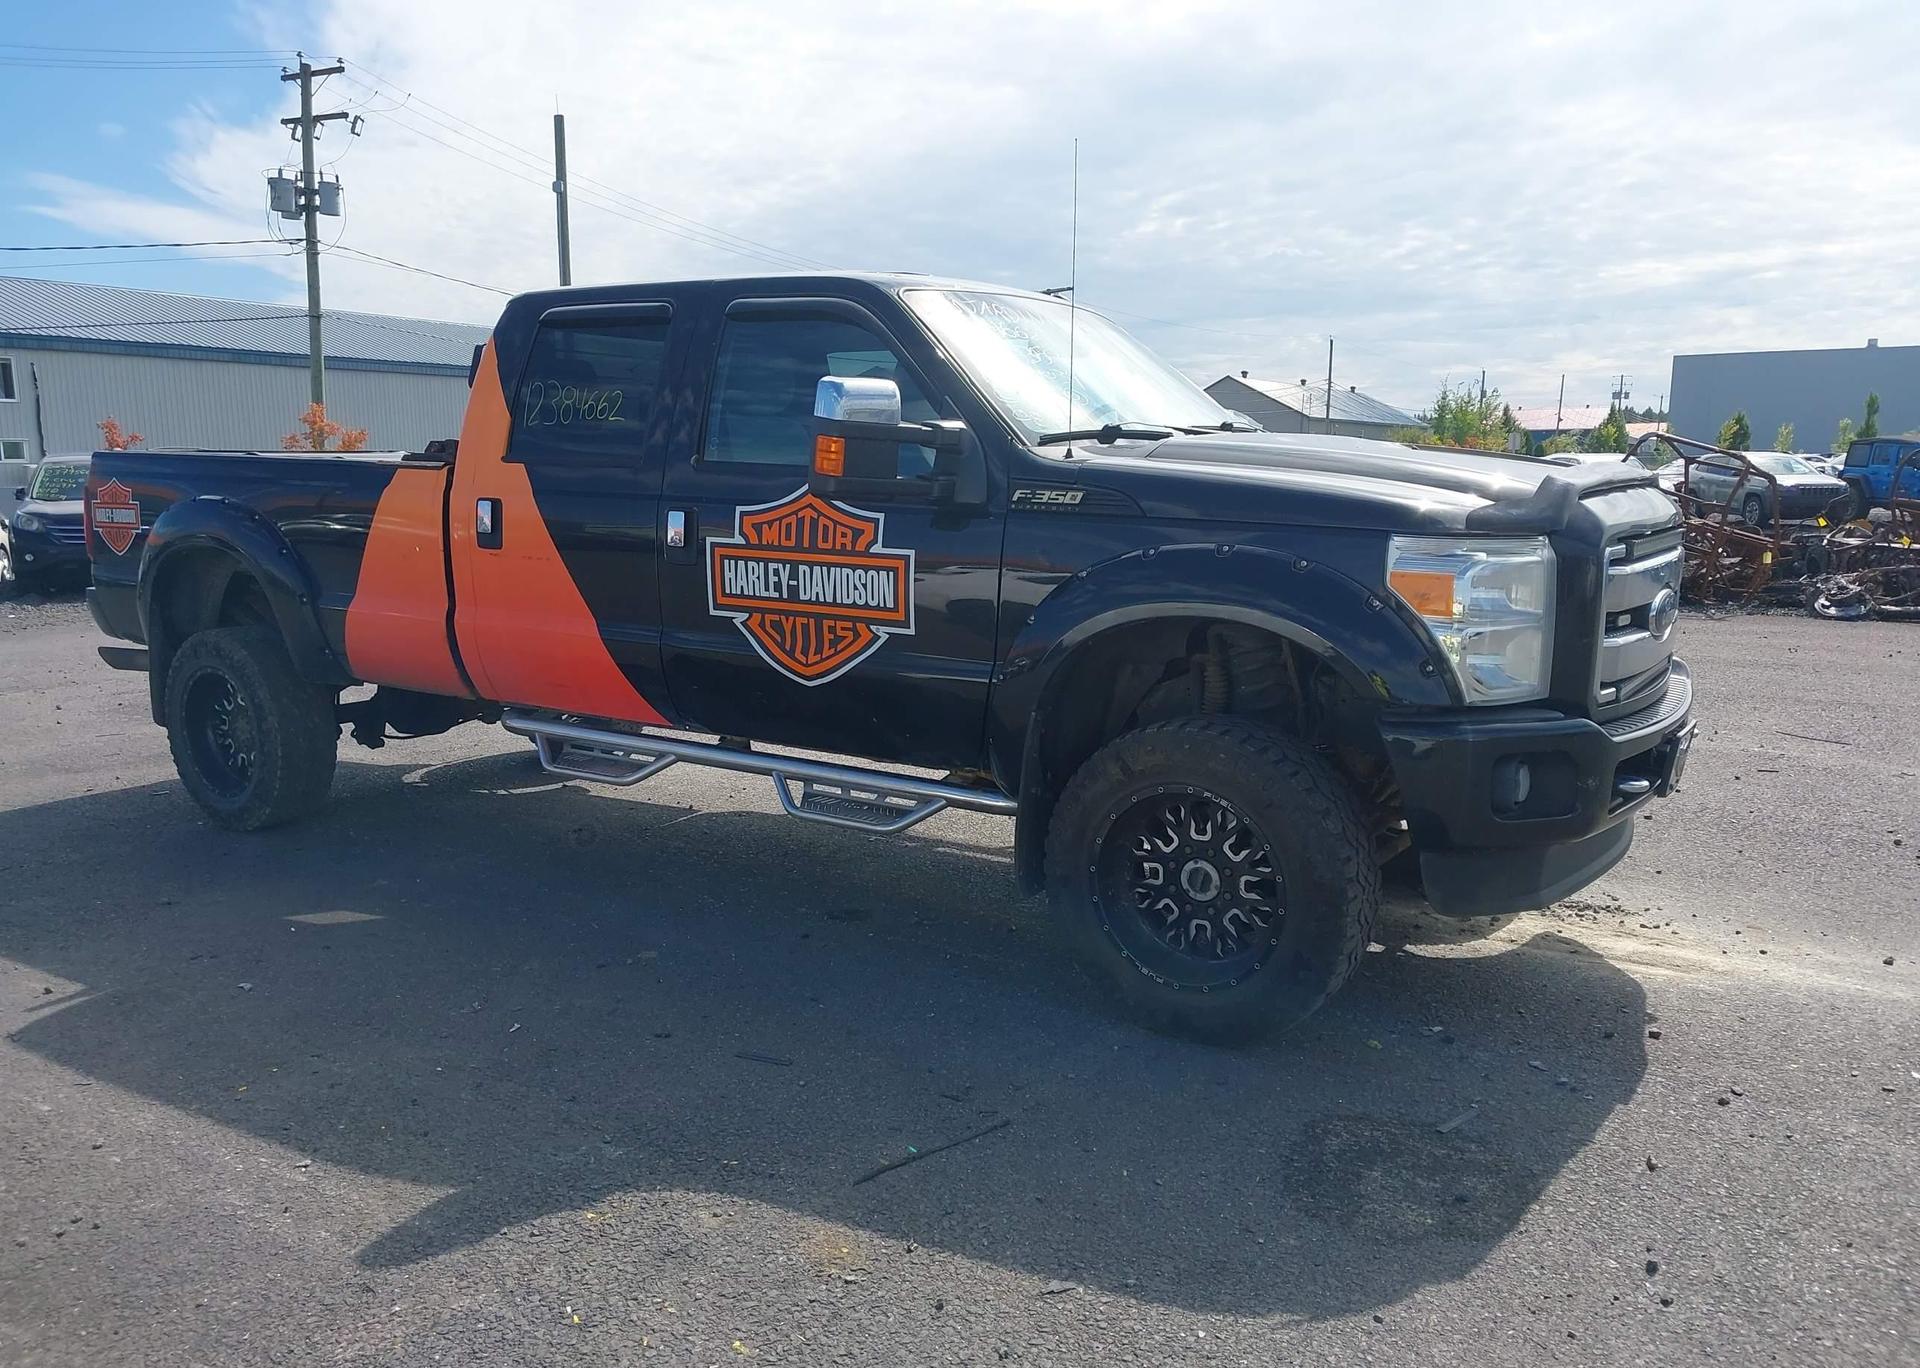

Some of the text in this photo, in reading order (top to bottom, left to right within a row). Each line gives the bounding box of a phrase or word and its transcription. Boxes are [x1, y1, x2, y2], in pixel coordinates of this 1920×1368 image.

[524, 380, 625, 428] 12384662
[1011, 489, 1085, 504] F-350
[761, 507, 853, 550] MOTOR
[723, 559, 894, 608] HARLEY-DAVIDSON
[764, 614, 853, 665] CYCLES
[1203, 791, 1235, 813] FUEL
